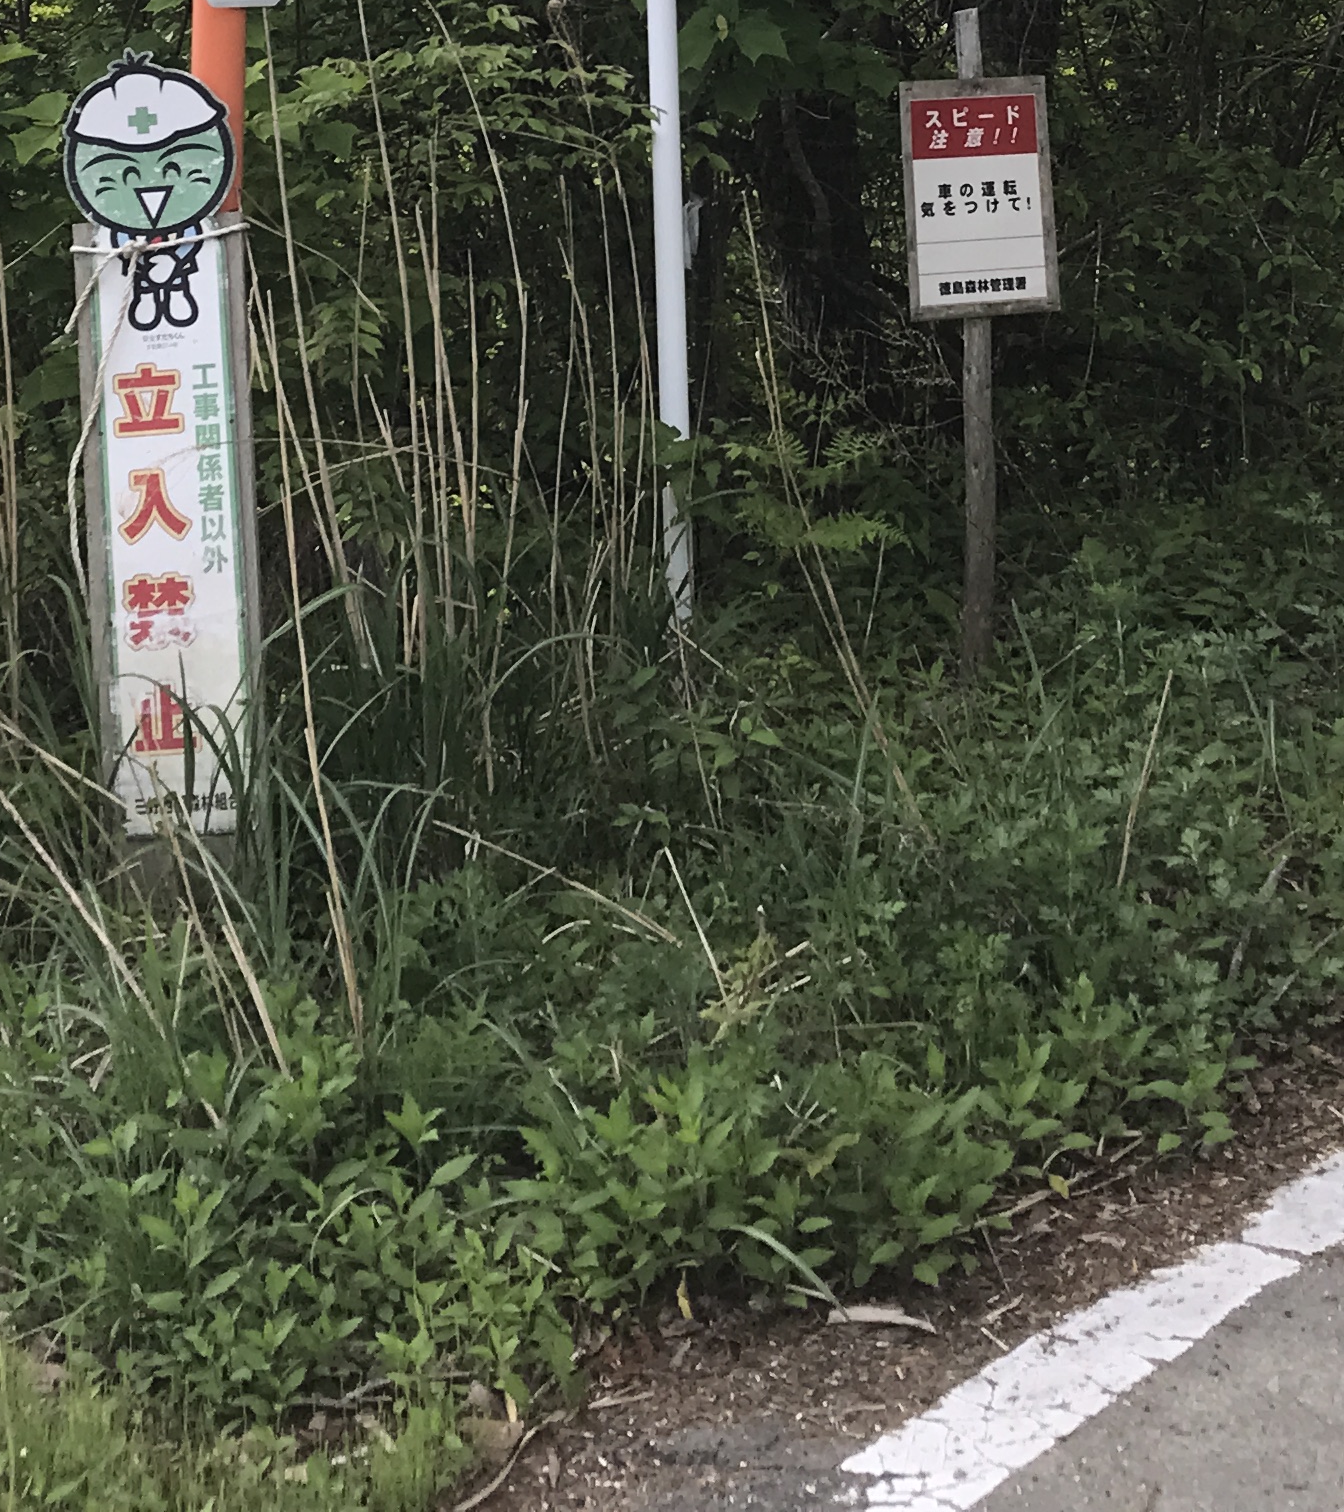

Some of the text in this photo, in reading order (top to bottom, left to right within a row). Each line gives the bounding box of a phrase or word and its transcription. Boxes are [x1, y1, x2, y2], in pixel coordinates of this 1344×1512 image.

[925, 104, 1020, 129] スピード
[937, 179, 1018, 199] 車の運転
[191, 362, 229, 574] 工事関係者以外
[114, 363, 202, 754] 立入禁止
